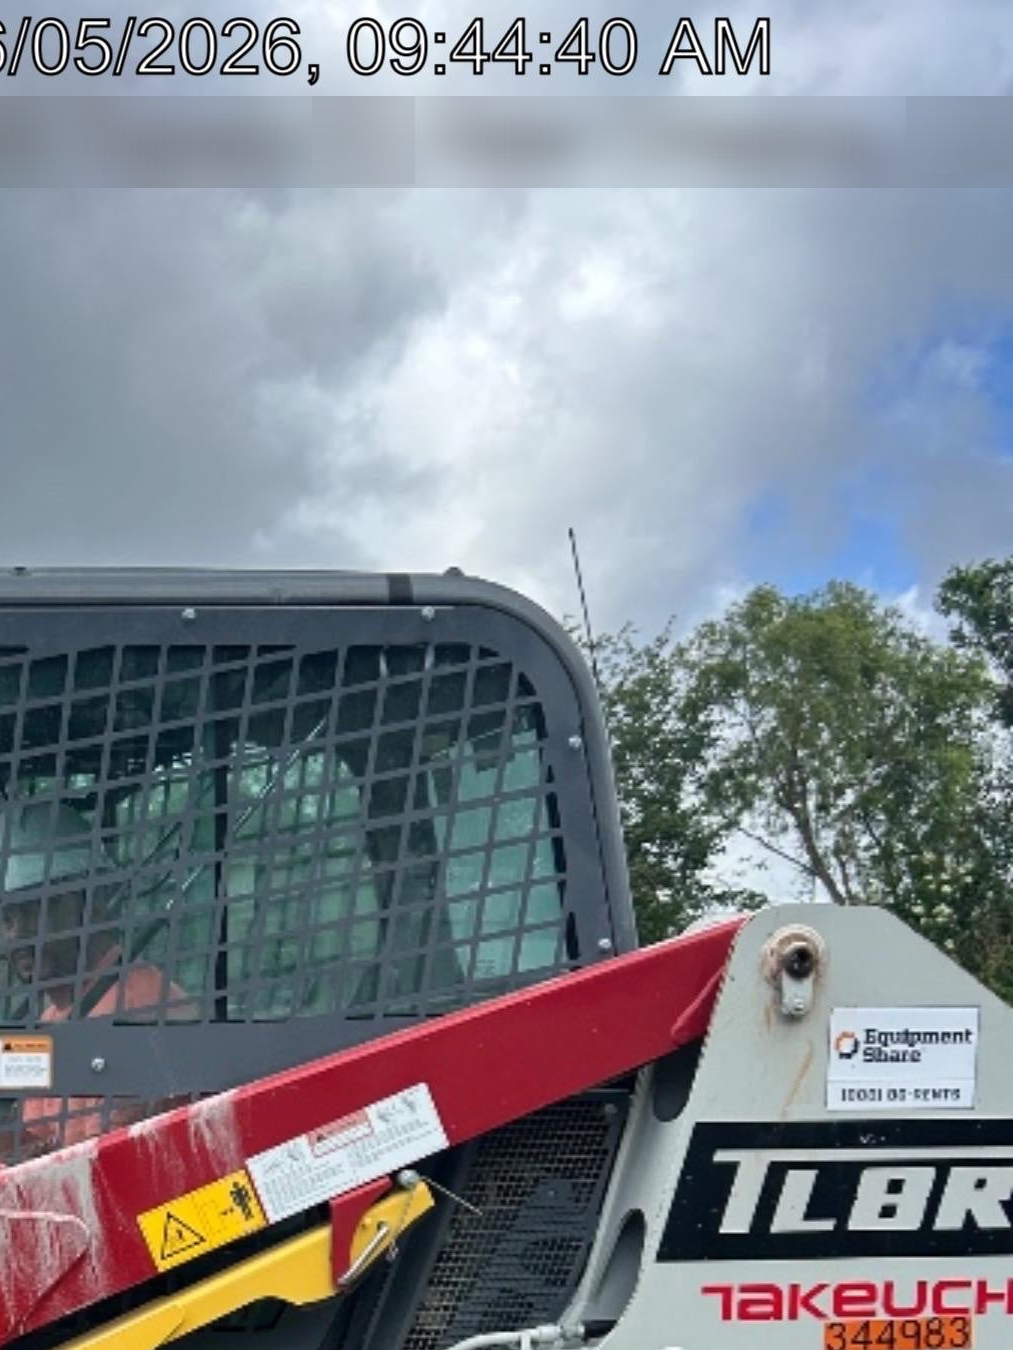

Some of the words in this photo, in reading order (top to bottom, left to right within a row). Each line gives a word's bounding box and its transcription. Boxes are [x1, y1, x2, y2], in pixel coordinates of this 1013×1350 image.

[863, 1028, 973, 1048] Equipment
[862, 1047, 922, 1063] Share
[712, 1147, 1013, 1234] TL8R
